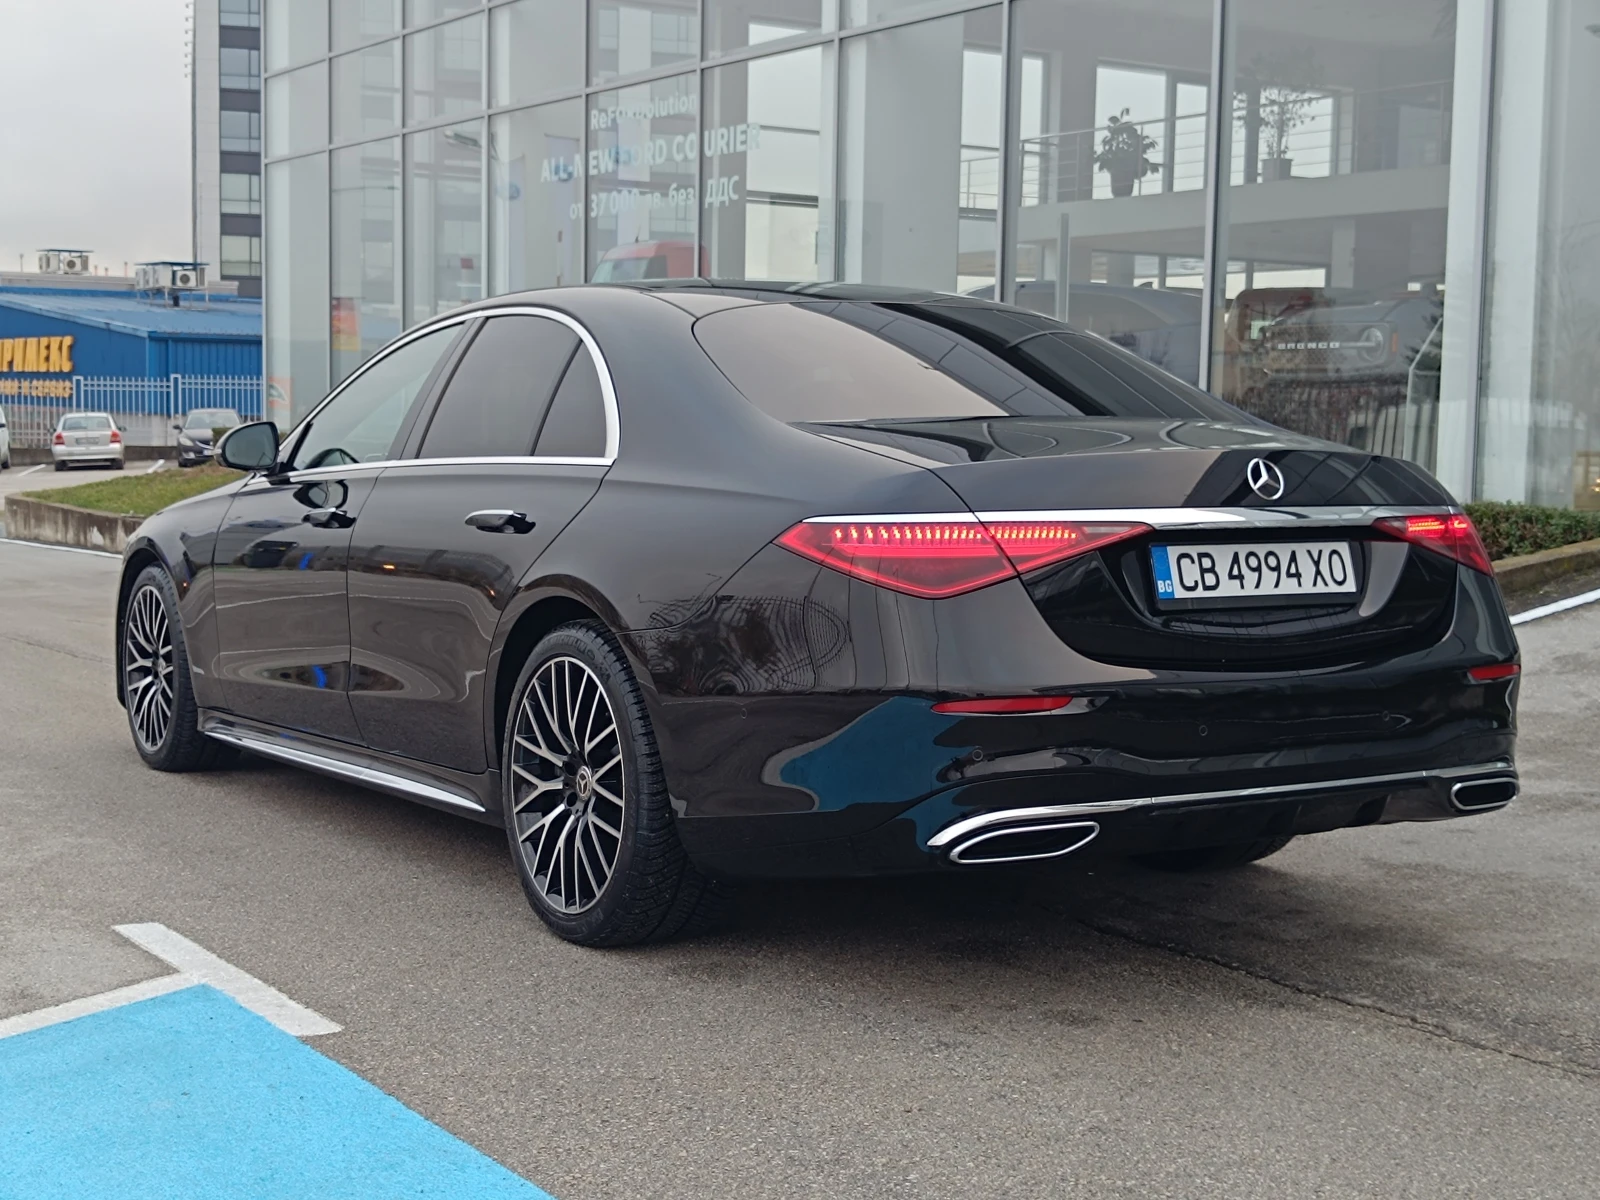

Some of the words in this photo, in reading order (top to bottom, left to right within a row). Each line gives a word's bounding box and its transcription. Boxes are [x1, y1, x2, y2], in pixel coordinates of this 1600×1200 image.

[619, 139, 667, 169] FORD
[672, 122, 761, 161] COURIER
[668, 182, 695, 206] без
[705, 175, 740, 209] ДДС
[0, 335, 74, 372] РИМЕКС
[1277, 341, 1340, 350] BRONCO
[1157, 580, 1172, 592] BG
[1176, 552, 1221, 592] CB
[1227, 550, 1303, 590] 4994
[1306, 549, 1348, 588] XO
